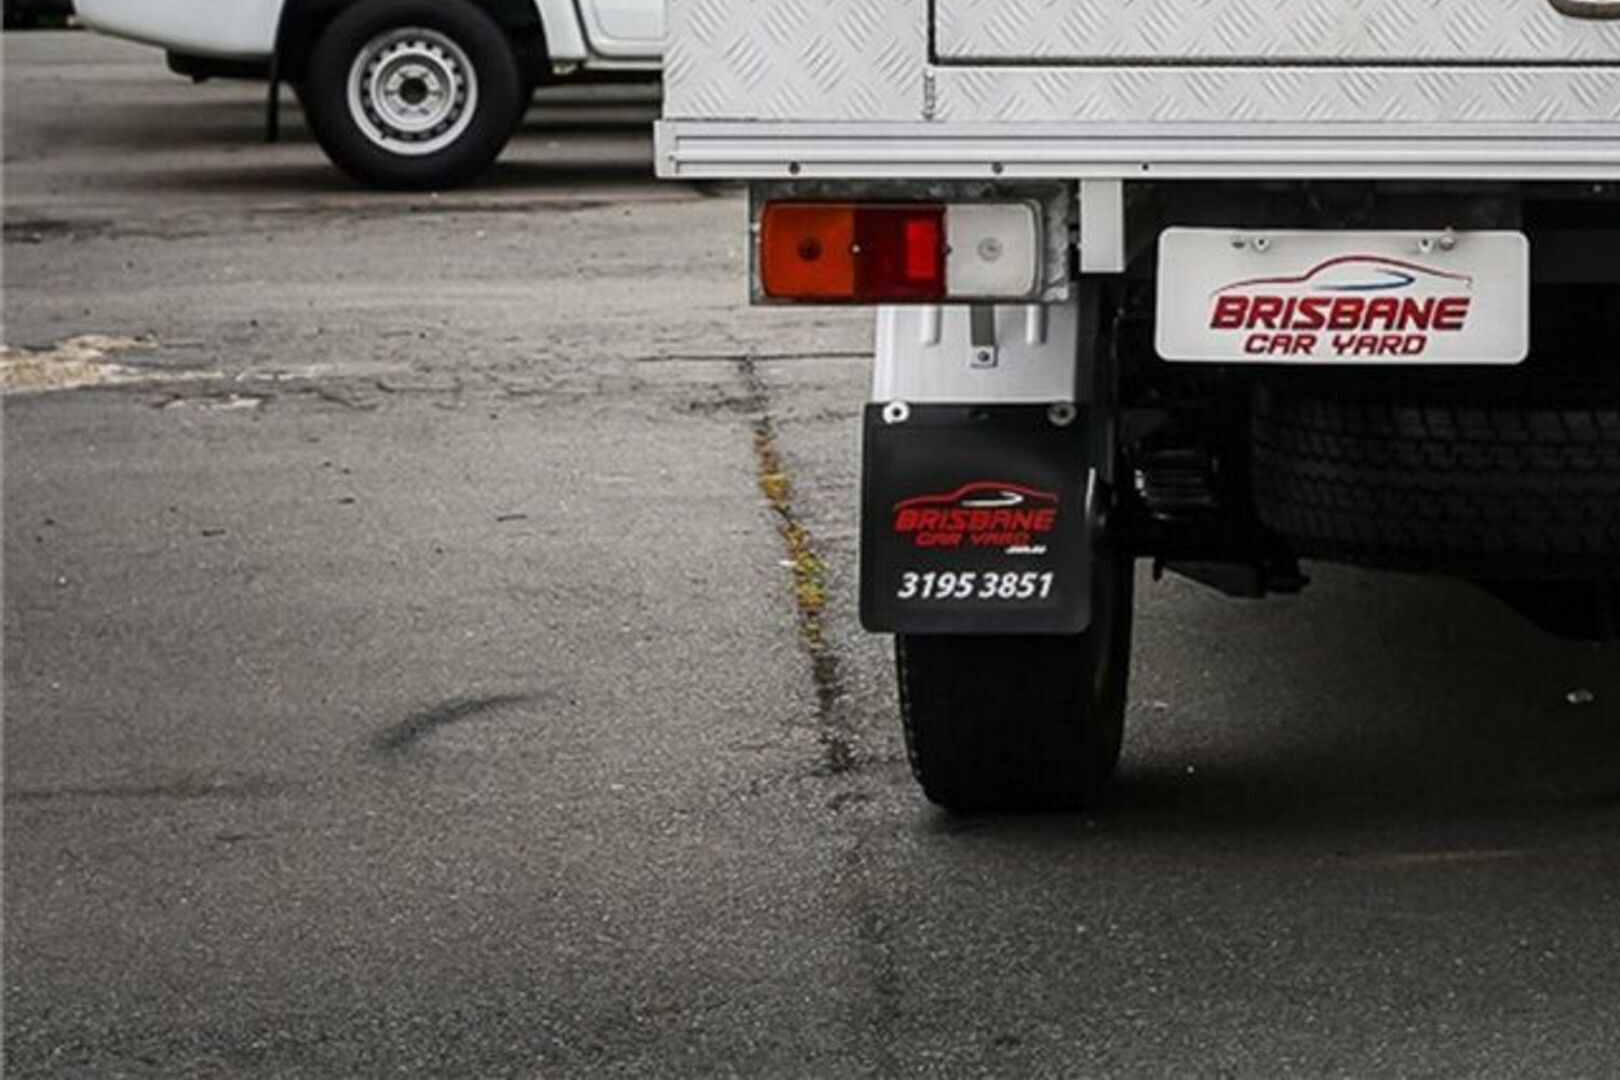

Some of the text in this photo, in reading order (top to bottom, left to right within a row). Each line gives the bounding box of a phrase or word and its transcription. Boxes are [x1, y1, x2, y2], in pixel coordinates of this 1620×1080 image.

[1210, 296, 1470, 330] BRISBANE
[1244, 334, 1428, 355] CAR YARD
[895, 508, 1057, 533] BRISBANE
[897, 572, 1053, 598] 3195 3851
